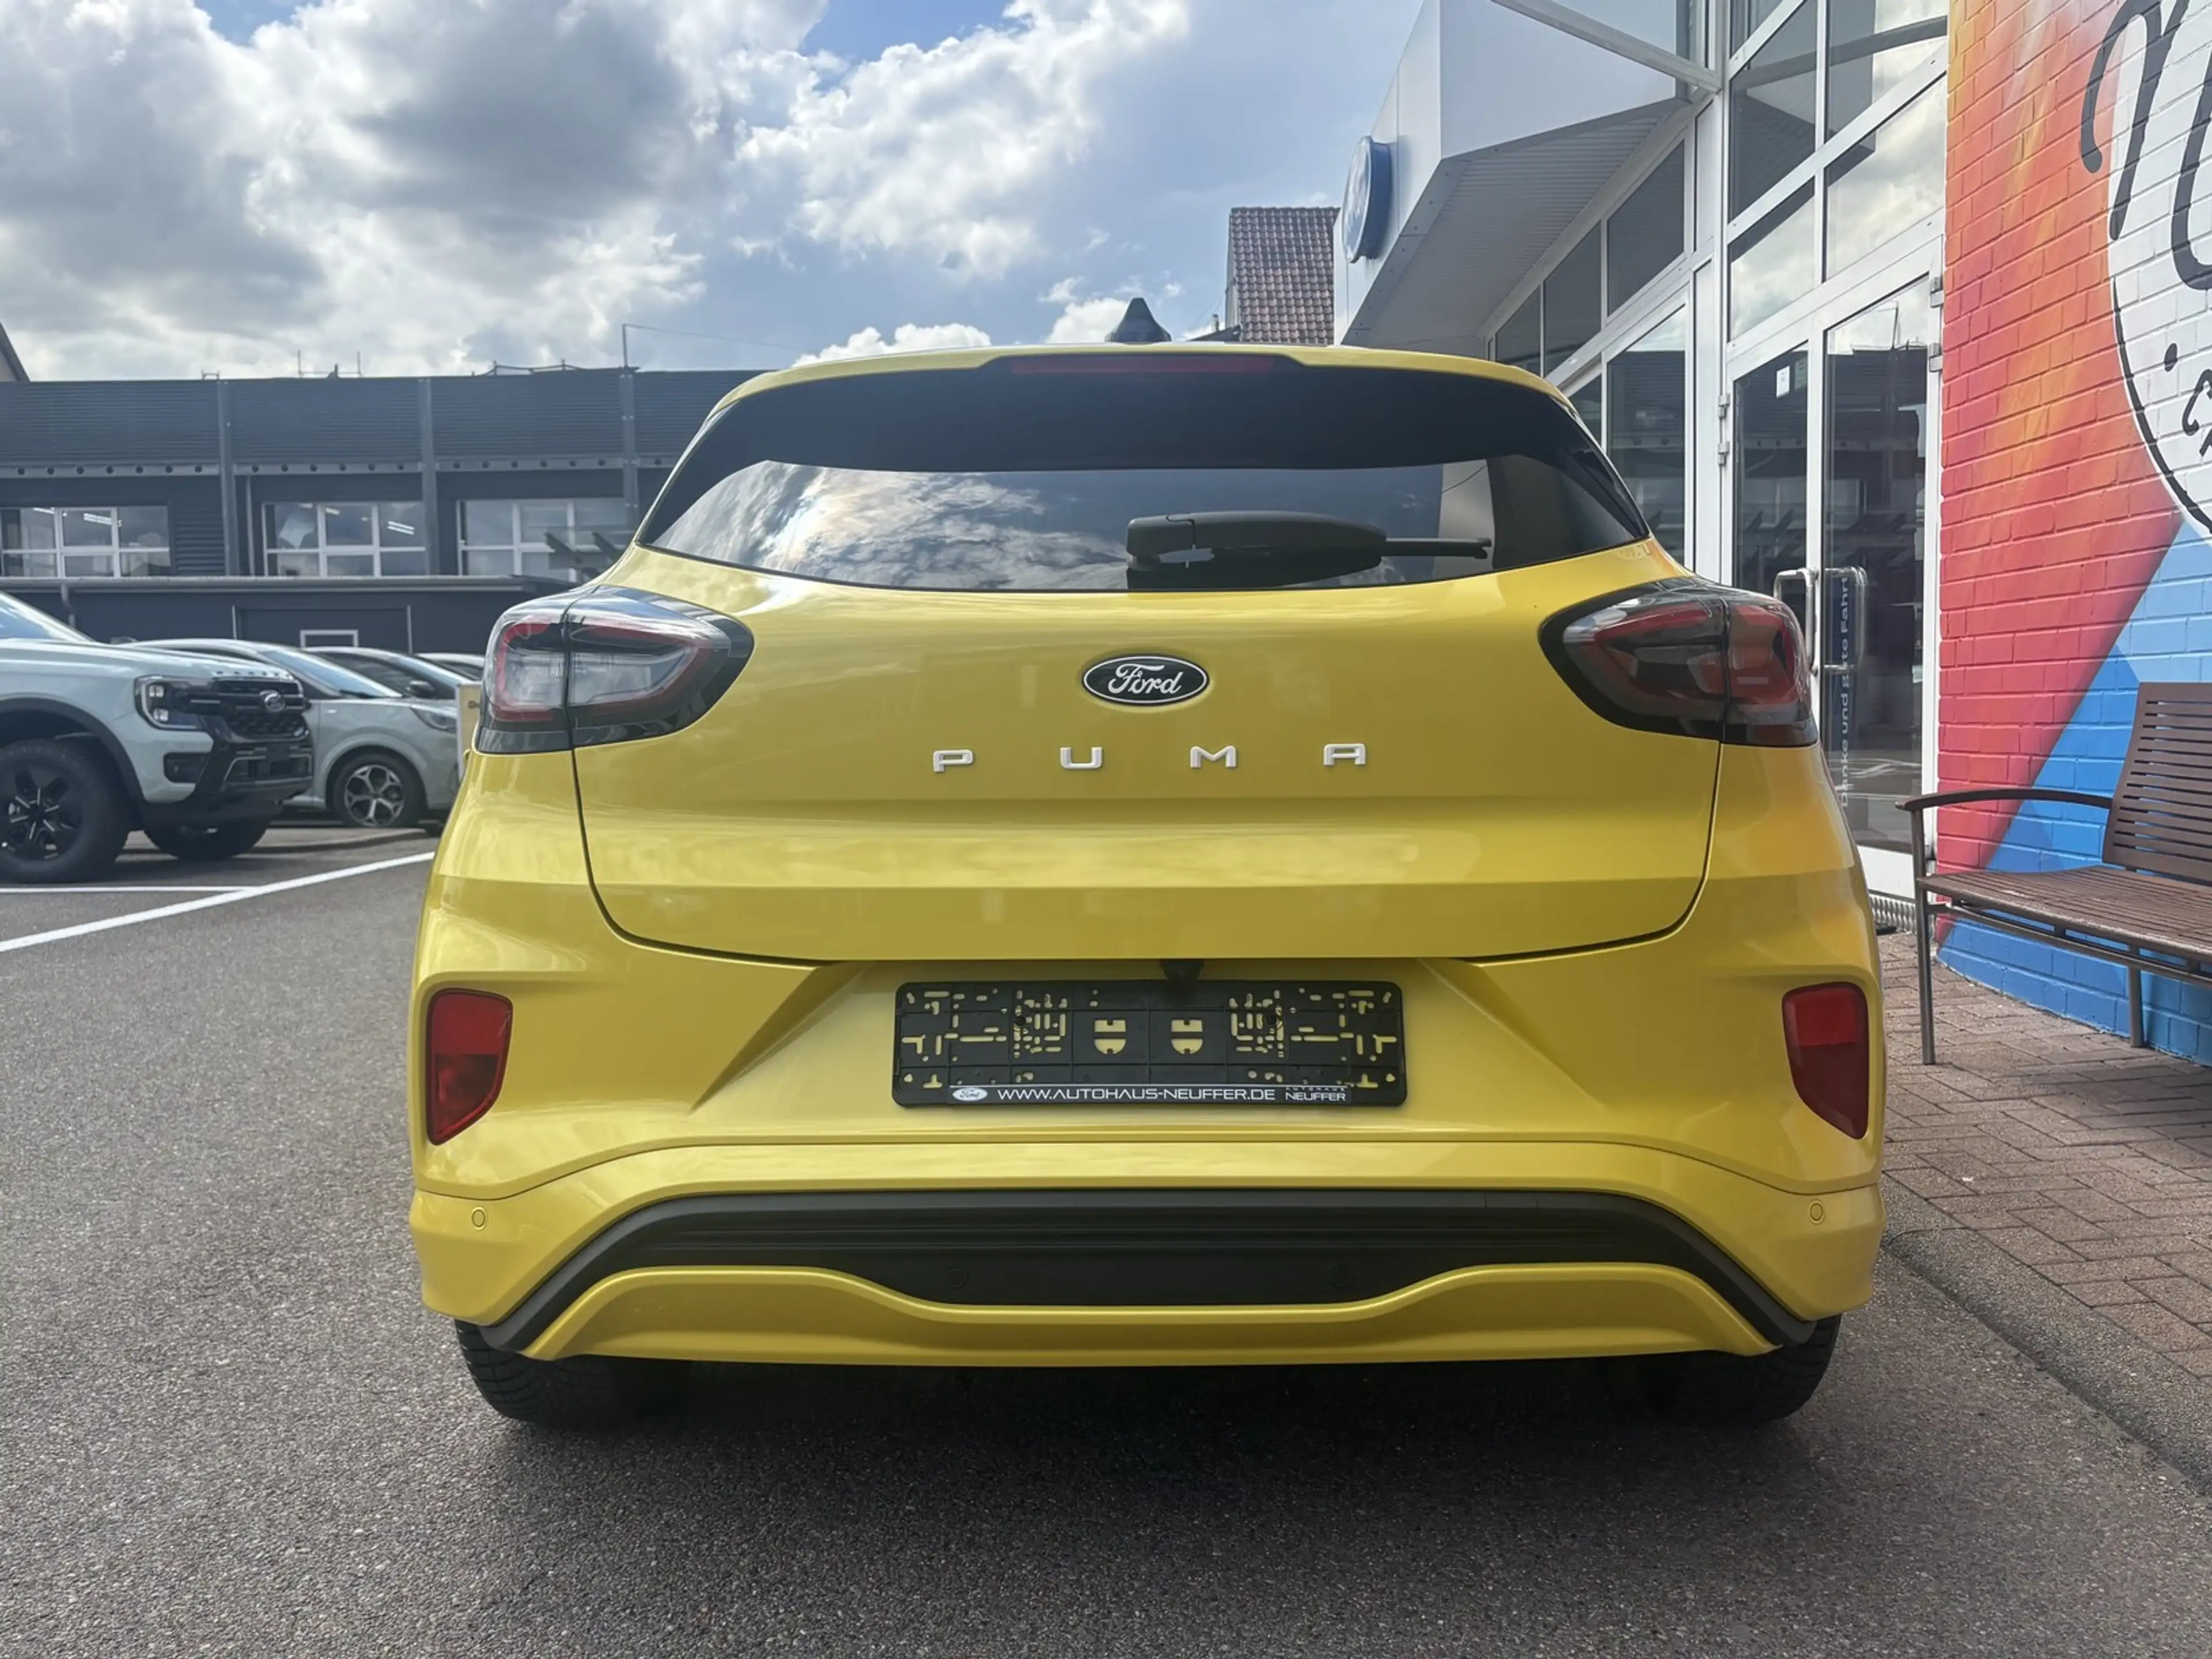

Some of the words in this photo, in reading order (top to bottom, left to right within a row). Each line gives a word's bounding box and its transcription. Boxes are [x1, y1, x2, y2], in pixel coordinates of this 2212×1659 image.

[1107, 663, 1183, 695] Ford
[1840, 693, 1849, 734] und
[933, 743, 1366, 772] PUMA
[997, 1089, 1275, 1100] WWW.AUTOHAUS-NEUFFER.DE
[1286, 1092, 1346, 1101] NEUFFER
